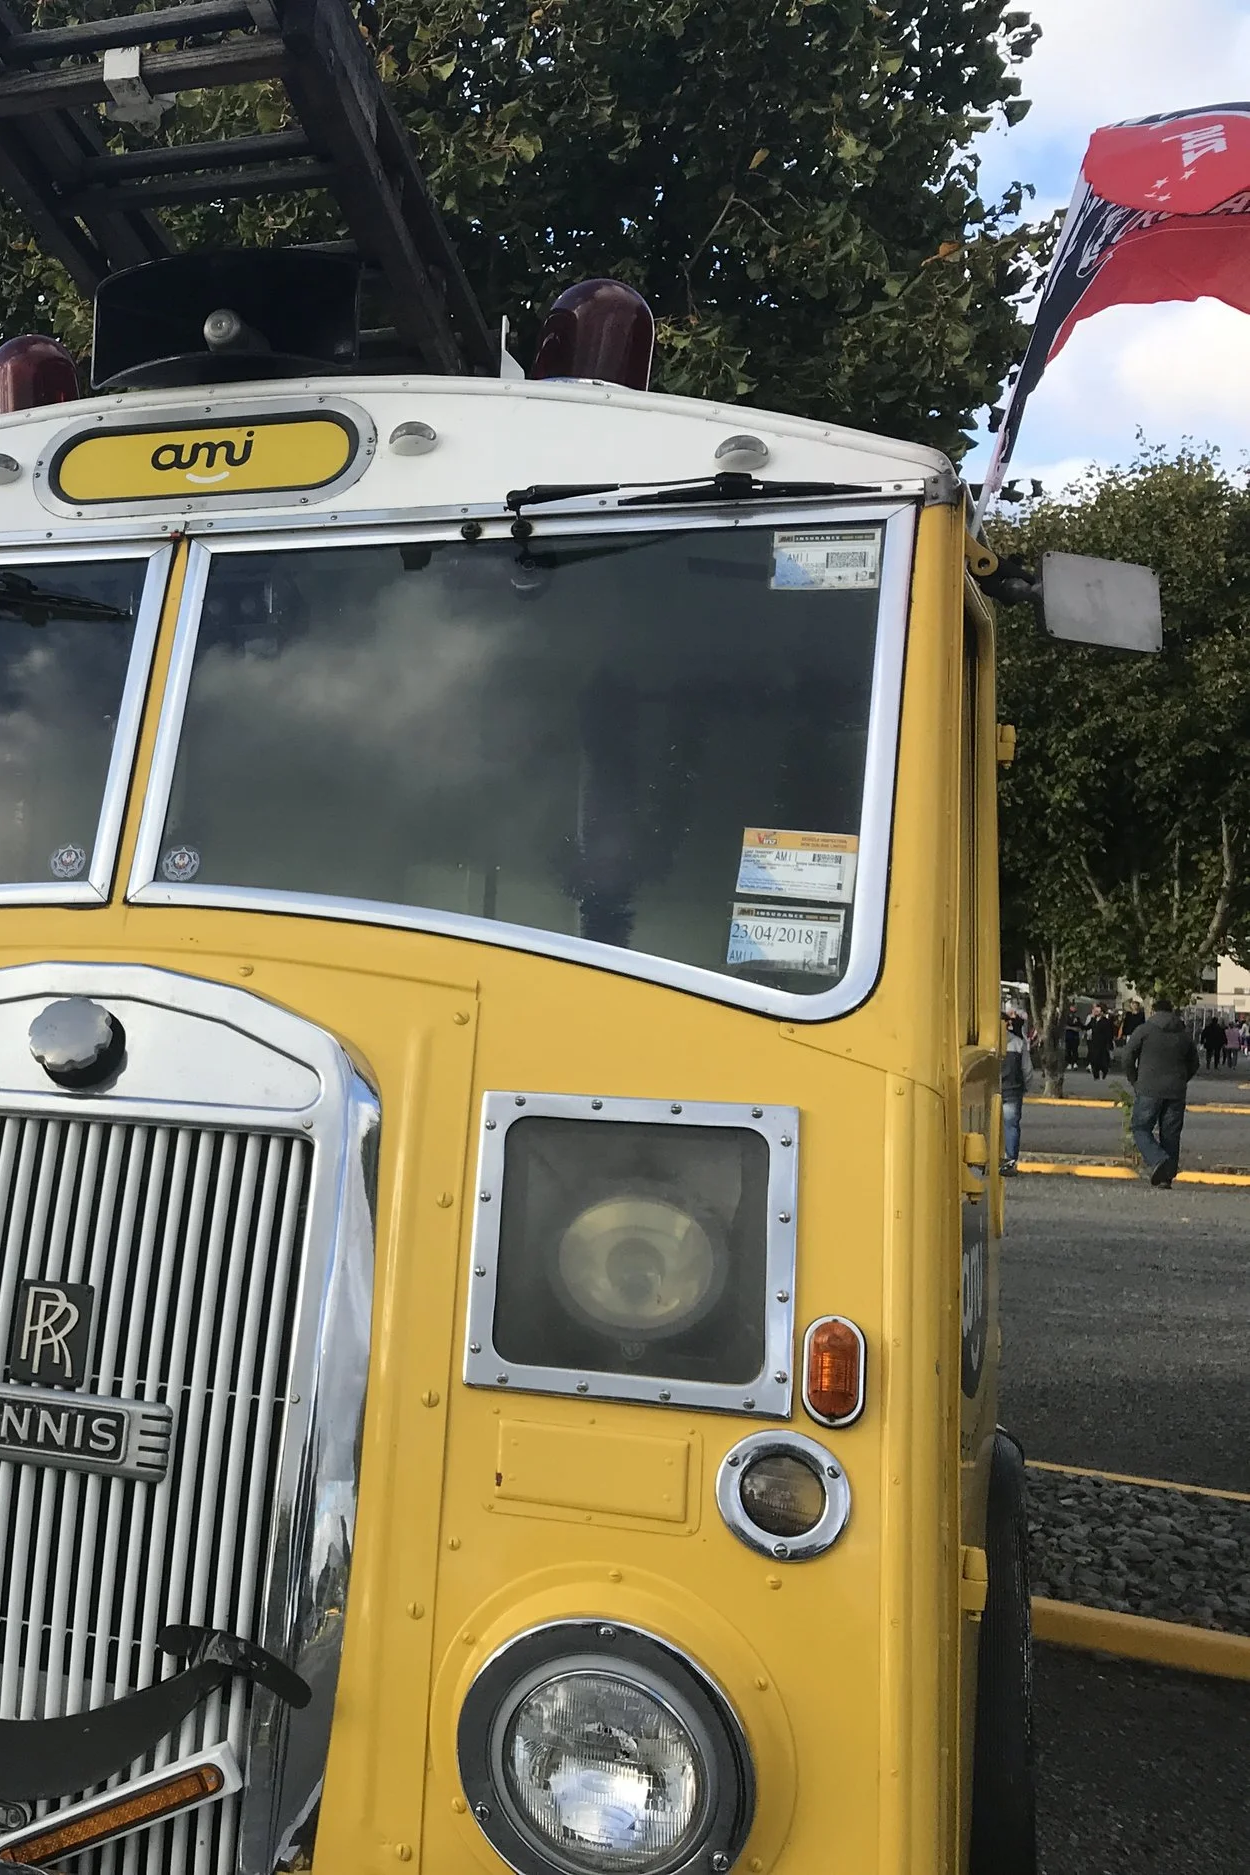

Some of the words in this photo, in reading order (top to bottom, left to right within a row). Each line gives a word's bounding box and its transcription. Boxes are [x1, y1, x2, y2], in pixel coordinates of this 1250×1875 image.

[150, 430, 255, 471] ami
[731, 923, 814, 944] 23/04/2018
[19, 1286, 80, 1378] RR
